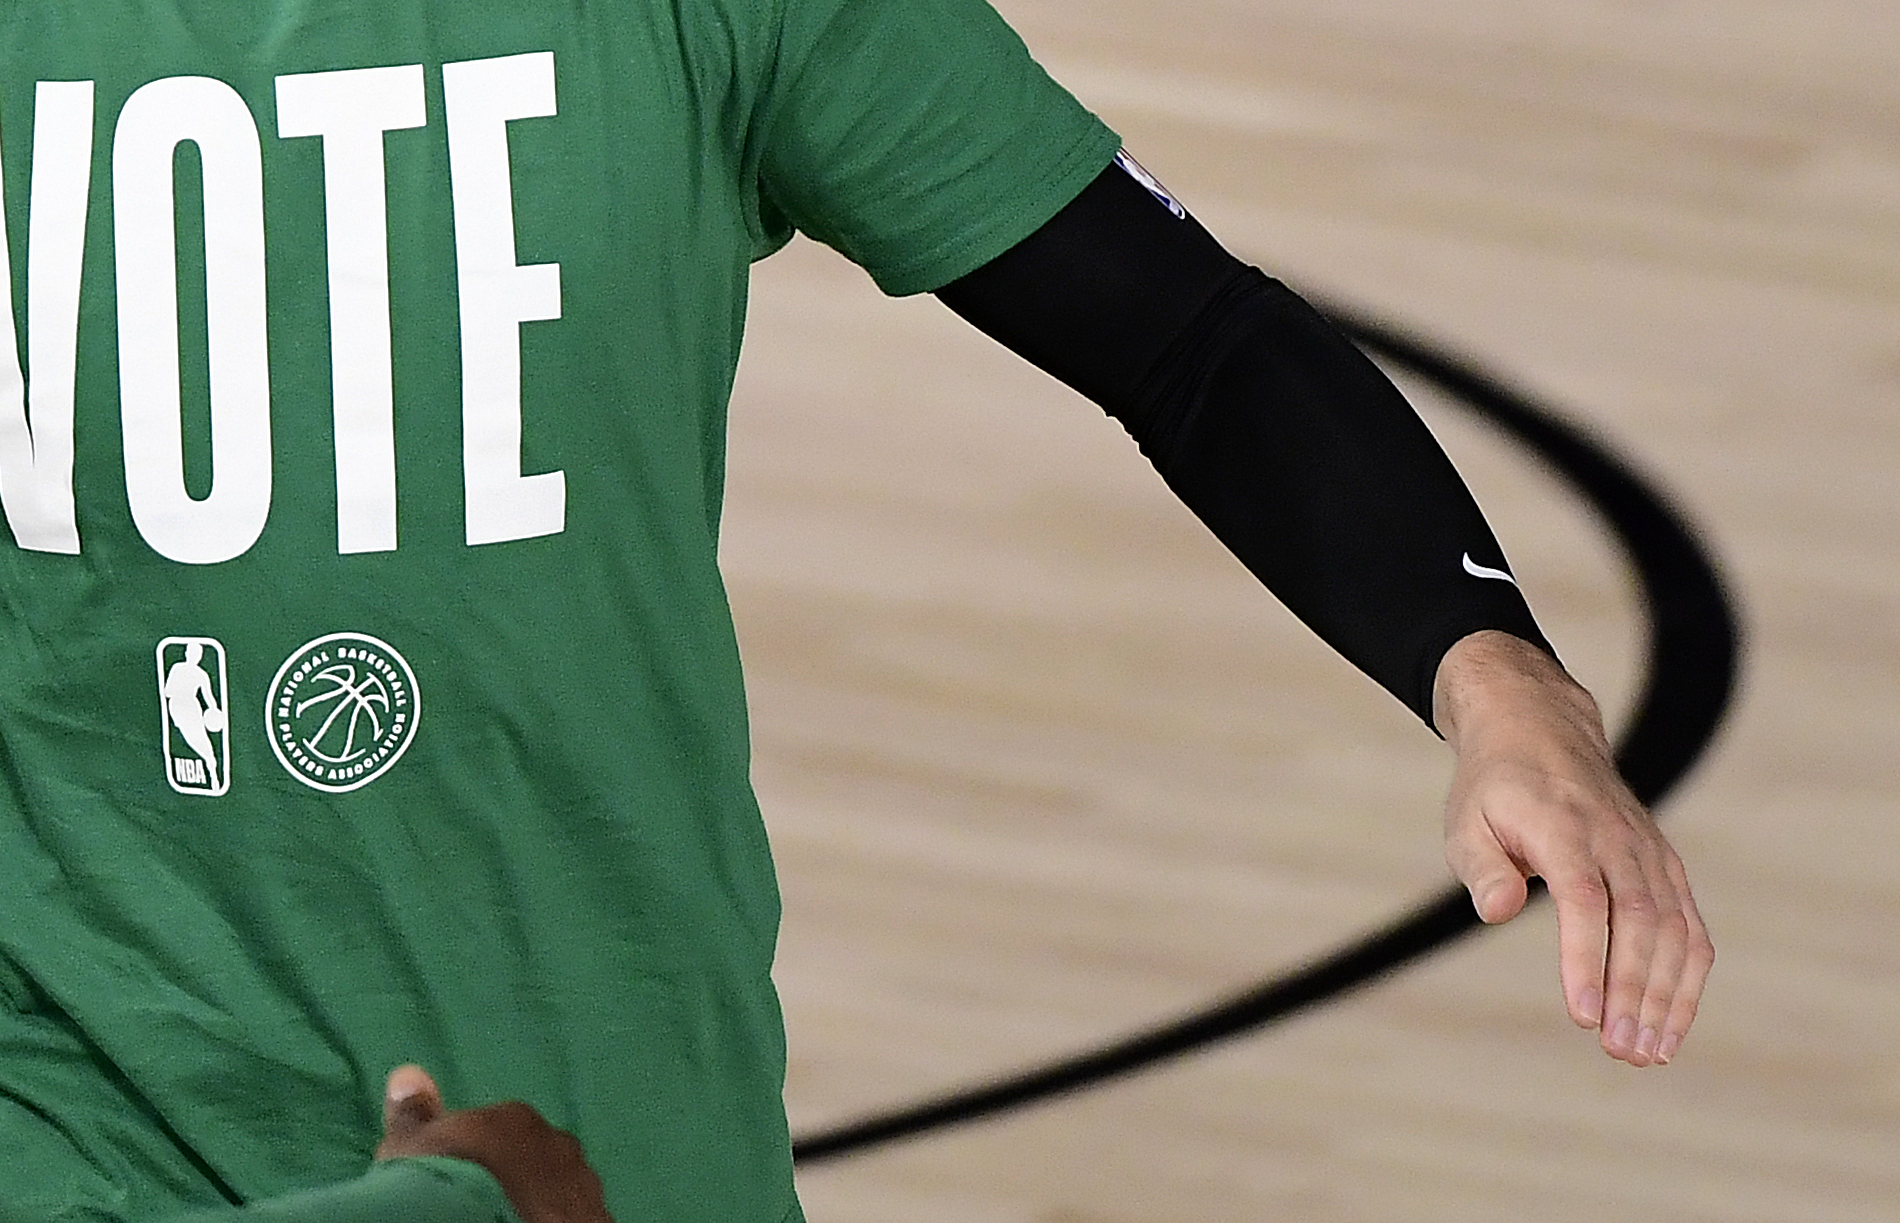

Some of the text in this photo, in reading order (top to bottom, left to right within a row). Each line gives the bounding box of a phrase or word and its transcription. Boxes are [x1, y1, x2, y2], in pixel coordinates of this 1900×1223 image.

[278, 647, 407, 718] NATIONAL BASKETBALL
[174, 757, 207, 785] NBA
[279, 713, 406, 780] PLAYERS ASSOCIATION
